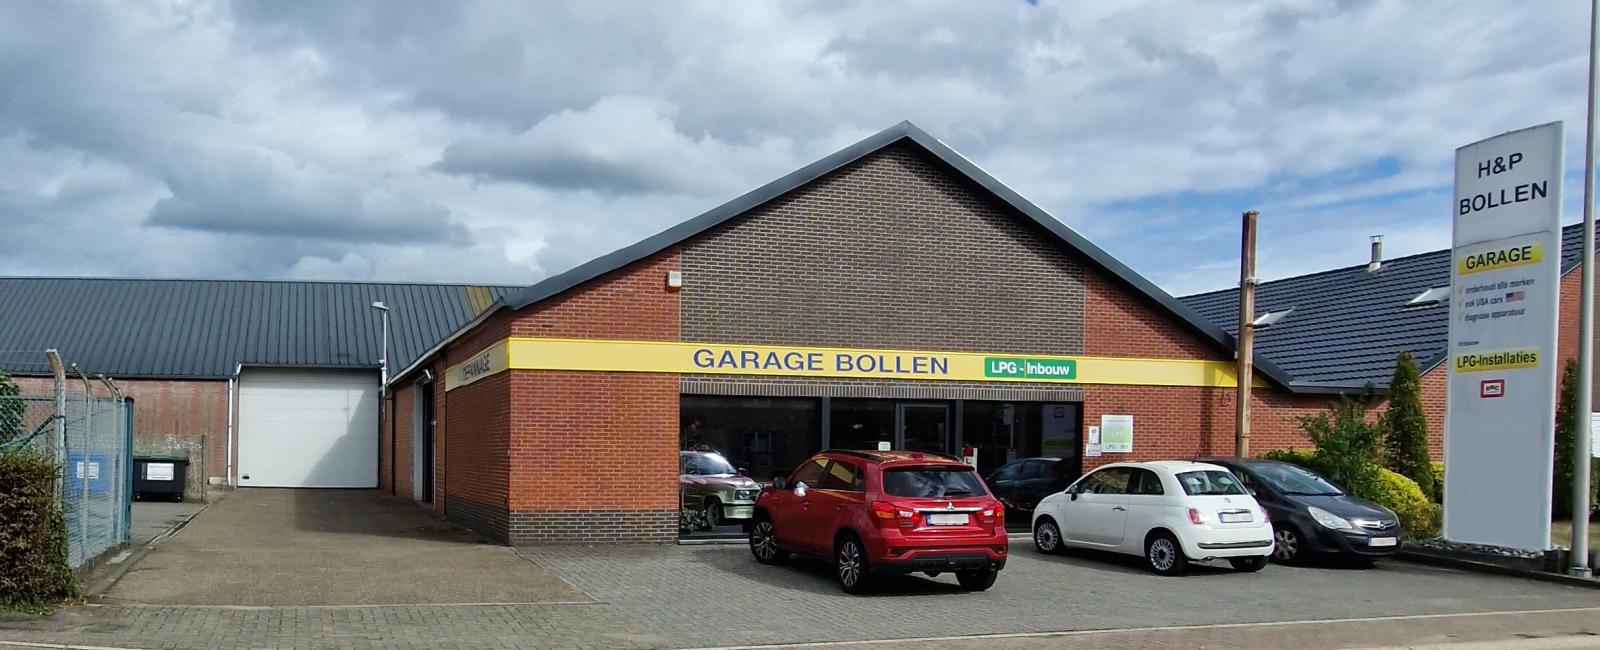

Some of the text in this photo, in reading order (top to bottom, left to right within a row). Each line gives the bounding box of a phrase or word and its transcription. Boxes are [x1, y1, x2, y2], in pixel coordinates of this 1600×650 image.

[1477, 152, 1523, 179] H&P
[1459, 180, 1547, 216] BOLLEN
[1465, 245, 1532, 270] GARAGE
[1497, 281, 1508, 290] alle
[1476, 298, 1489, 306] USA
[693, 348, 948, 375] GARAGE BOLLEN
[991, 360, 1017, 374] LPG
[1026, 361, 1070, 376] Inbouw
[1457, 350, 1537, 368] LPG-Installaties
